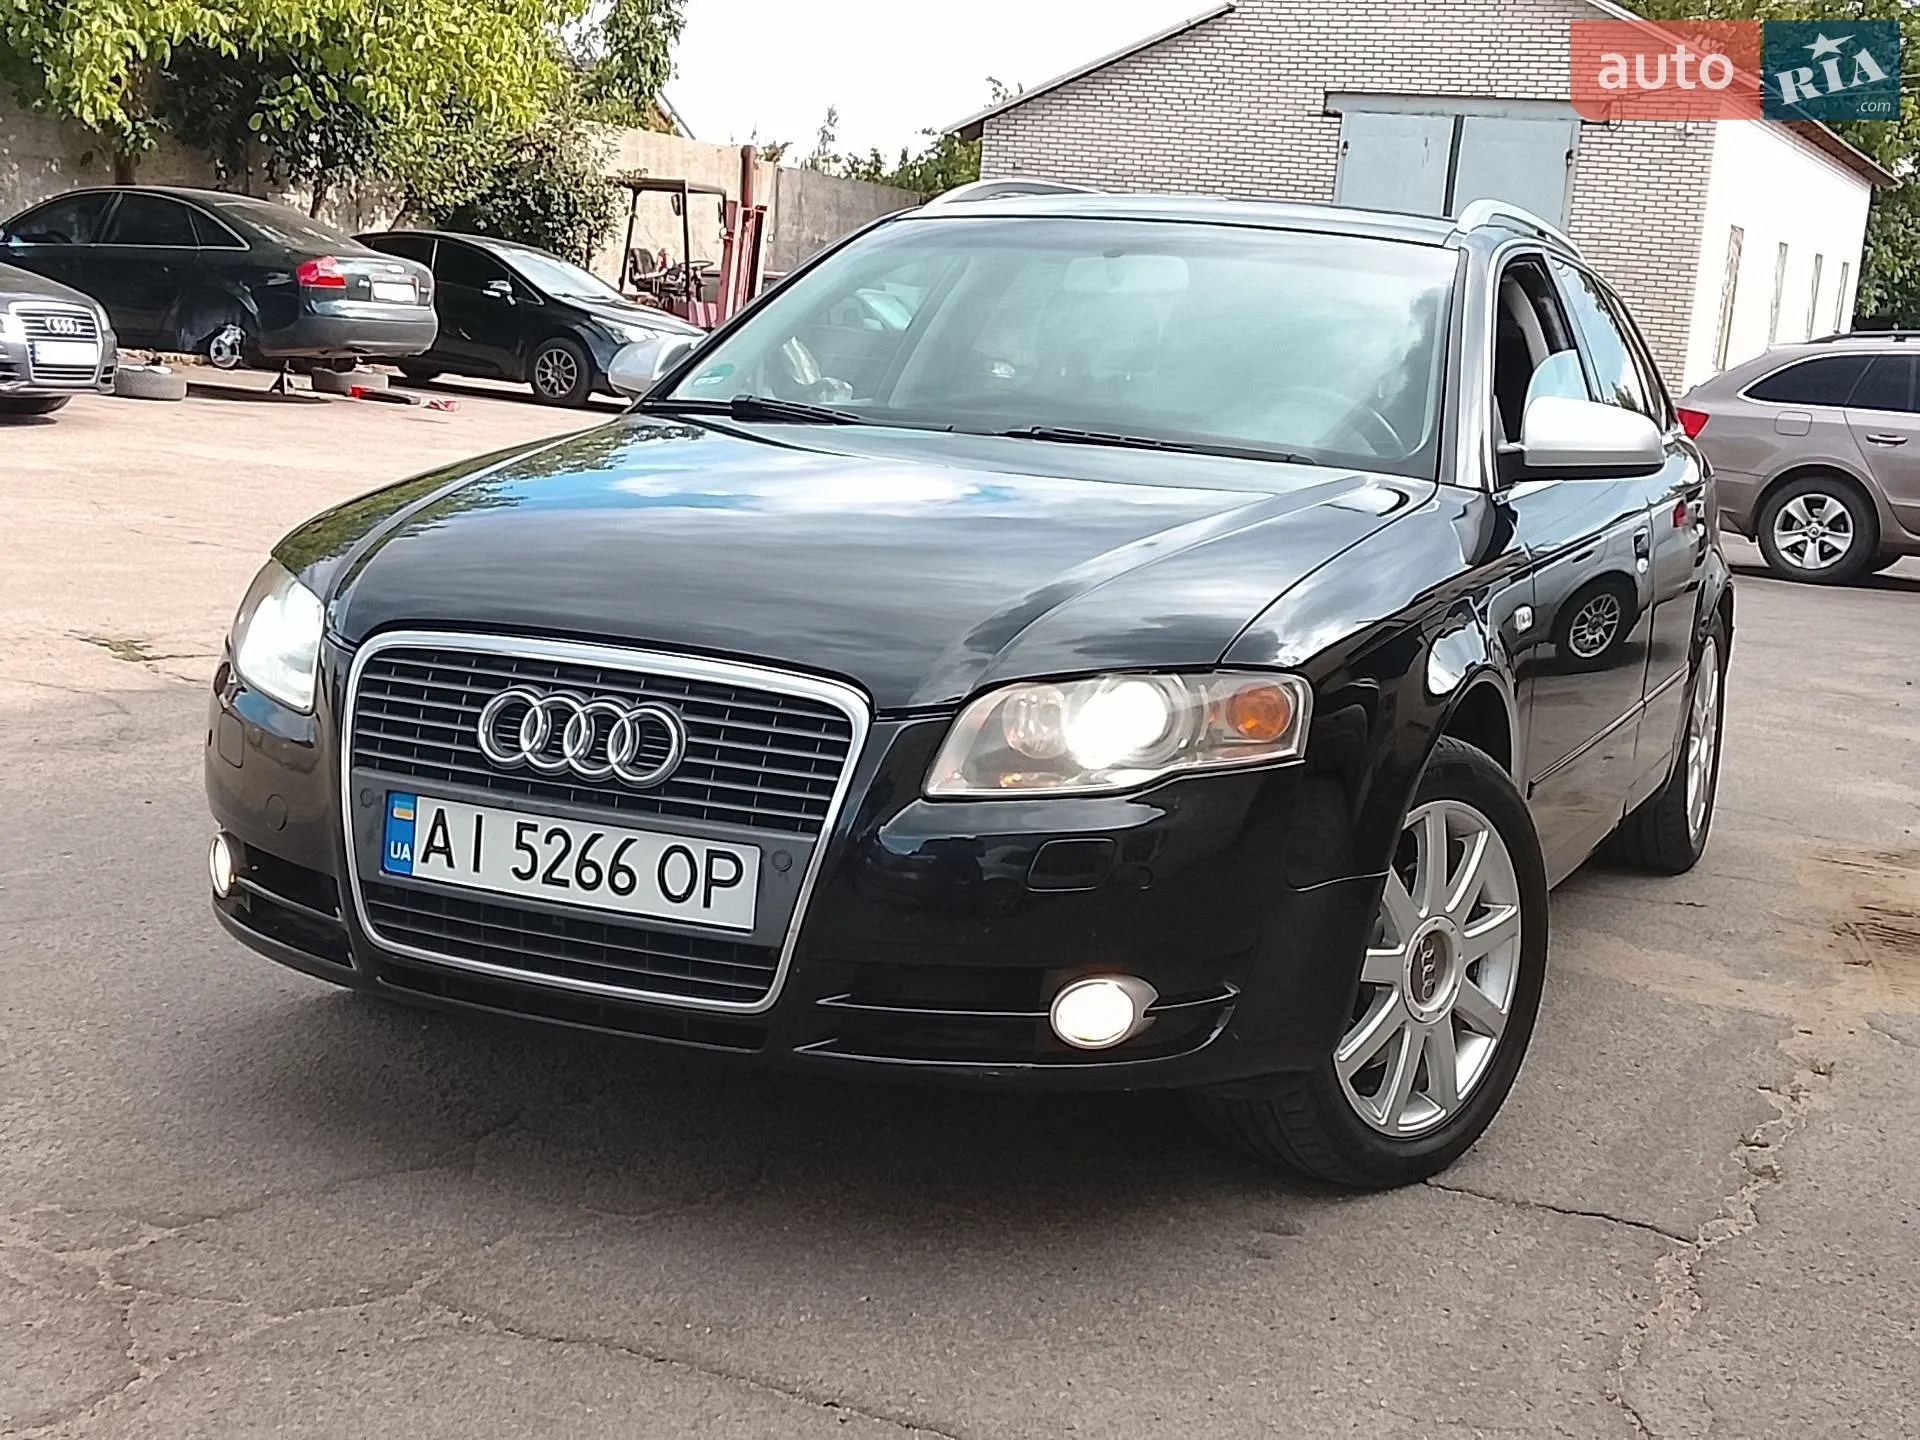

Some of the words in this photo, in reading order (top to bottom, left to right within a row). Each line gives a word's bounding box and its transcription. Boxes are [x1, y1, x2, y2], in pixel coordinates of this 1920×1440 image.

[389, 840, 413, 862] UA
[420, 807, 484, 874] AI
[510, 820, 640, 898] 5266
[656, 844, 745, 909] OP
